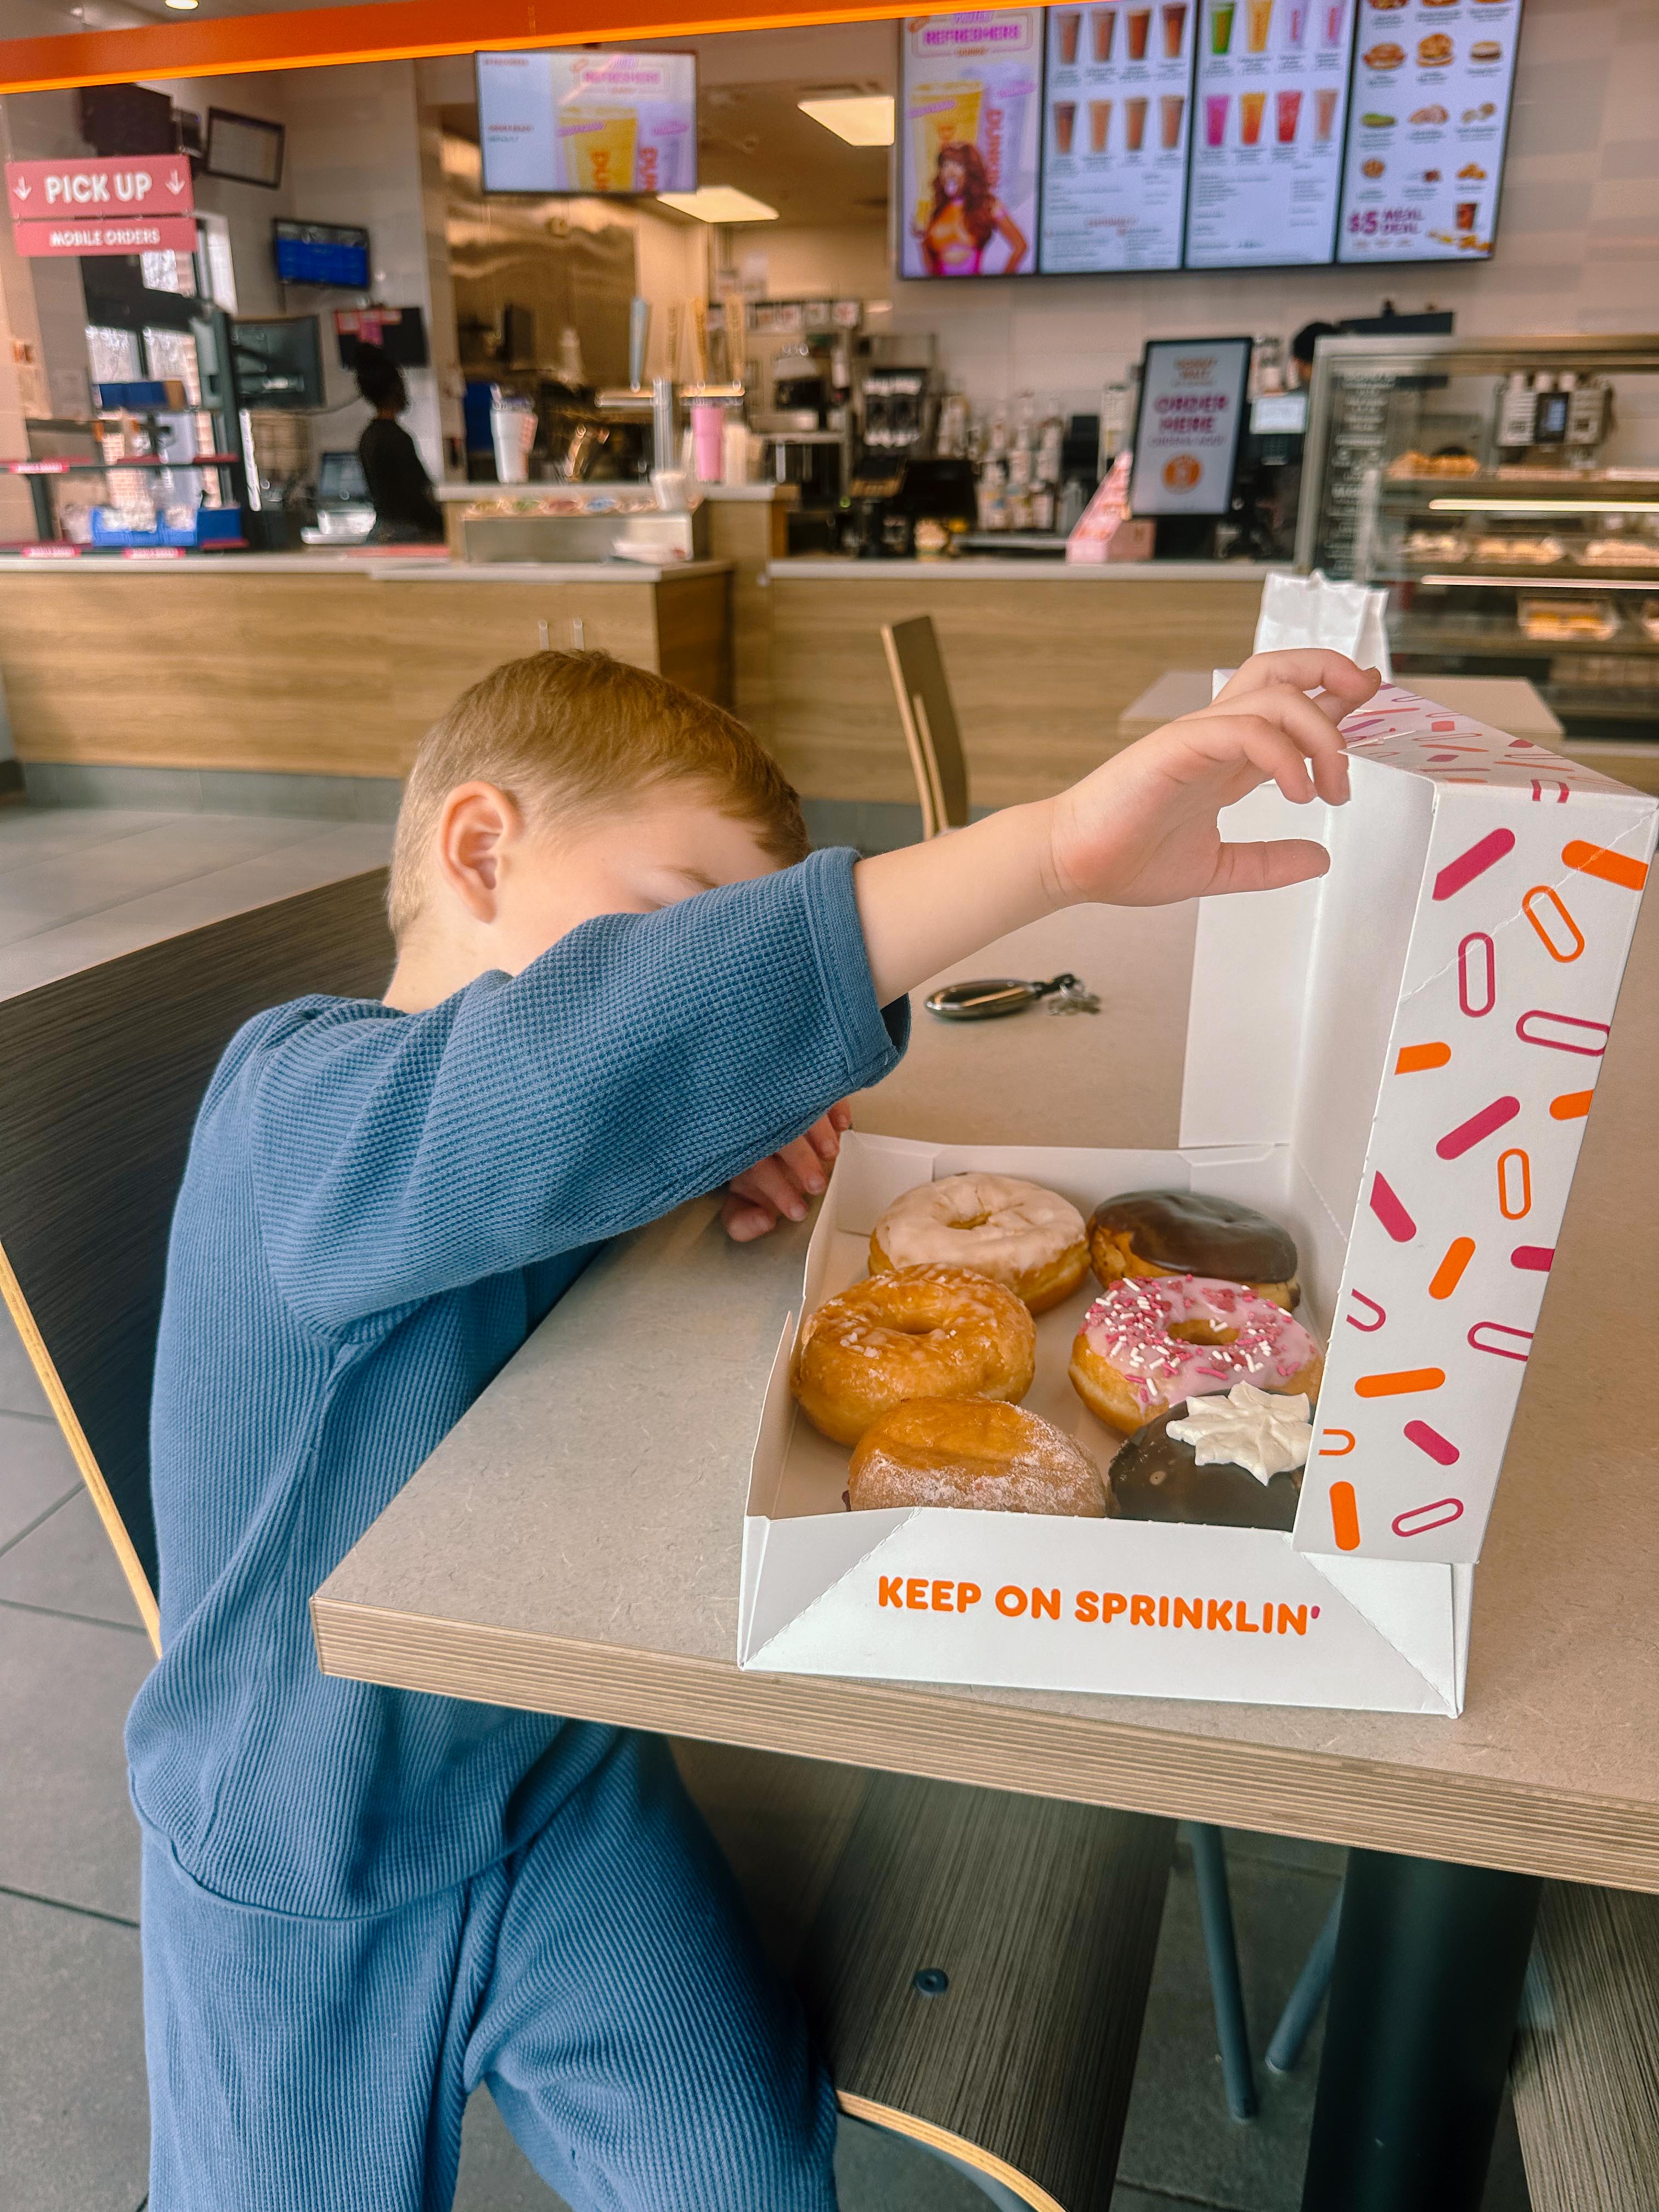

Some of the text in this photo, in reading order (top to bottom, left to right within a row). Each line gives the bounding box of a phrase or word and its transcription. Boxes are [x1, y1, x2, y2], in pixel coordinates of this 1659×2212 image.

[46, 171, 153, 204] PICK UP
[1350, 210, 1378, 234] $5
[50, 227, 161, 247] MOBILE ORDERS
[879, 1576, 1321, 1635] KEEP ON SPRINKLIN'
